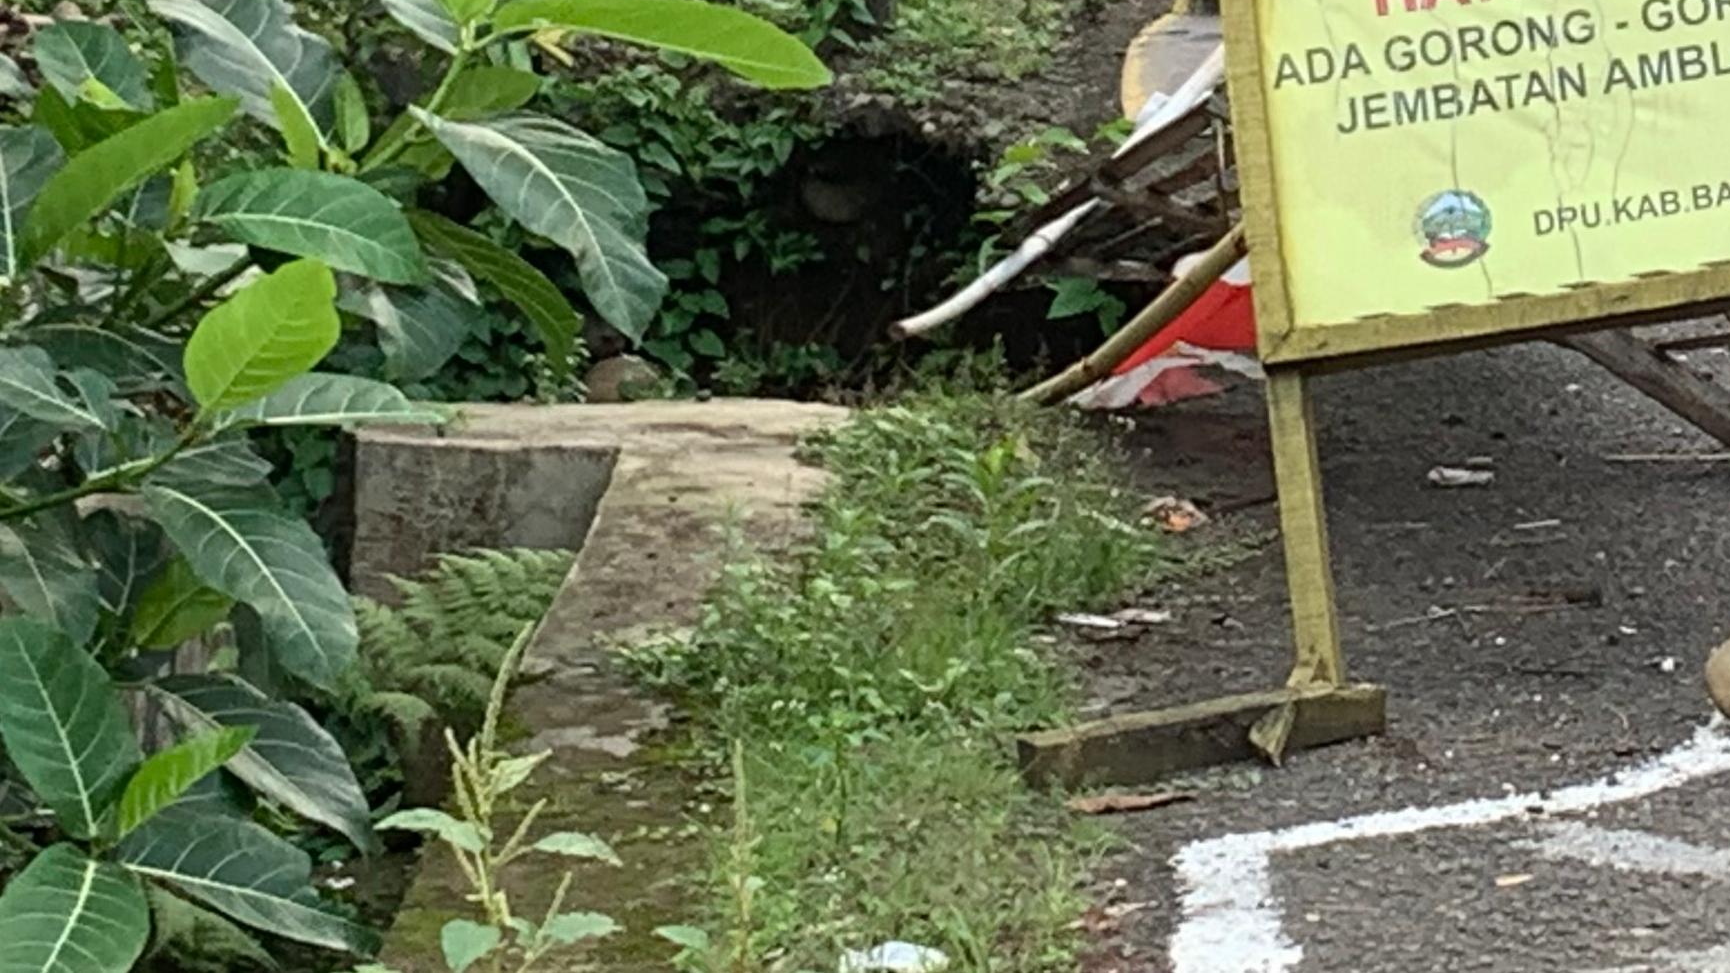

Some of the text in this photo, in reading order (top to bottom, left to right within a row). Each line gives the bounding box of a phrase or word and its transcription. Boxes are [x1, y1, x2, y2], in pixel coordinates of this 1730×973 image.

[1273, 42, 1372, 90] ADA
[1384, 9, 1596, 73] GORONG
[1337, 62, 1588, 134] JEMBATAN
